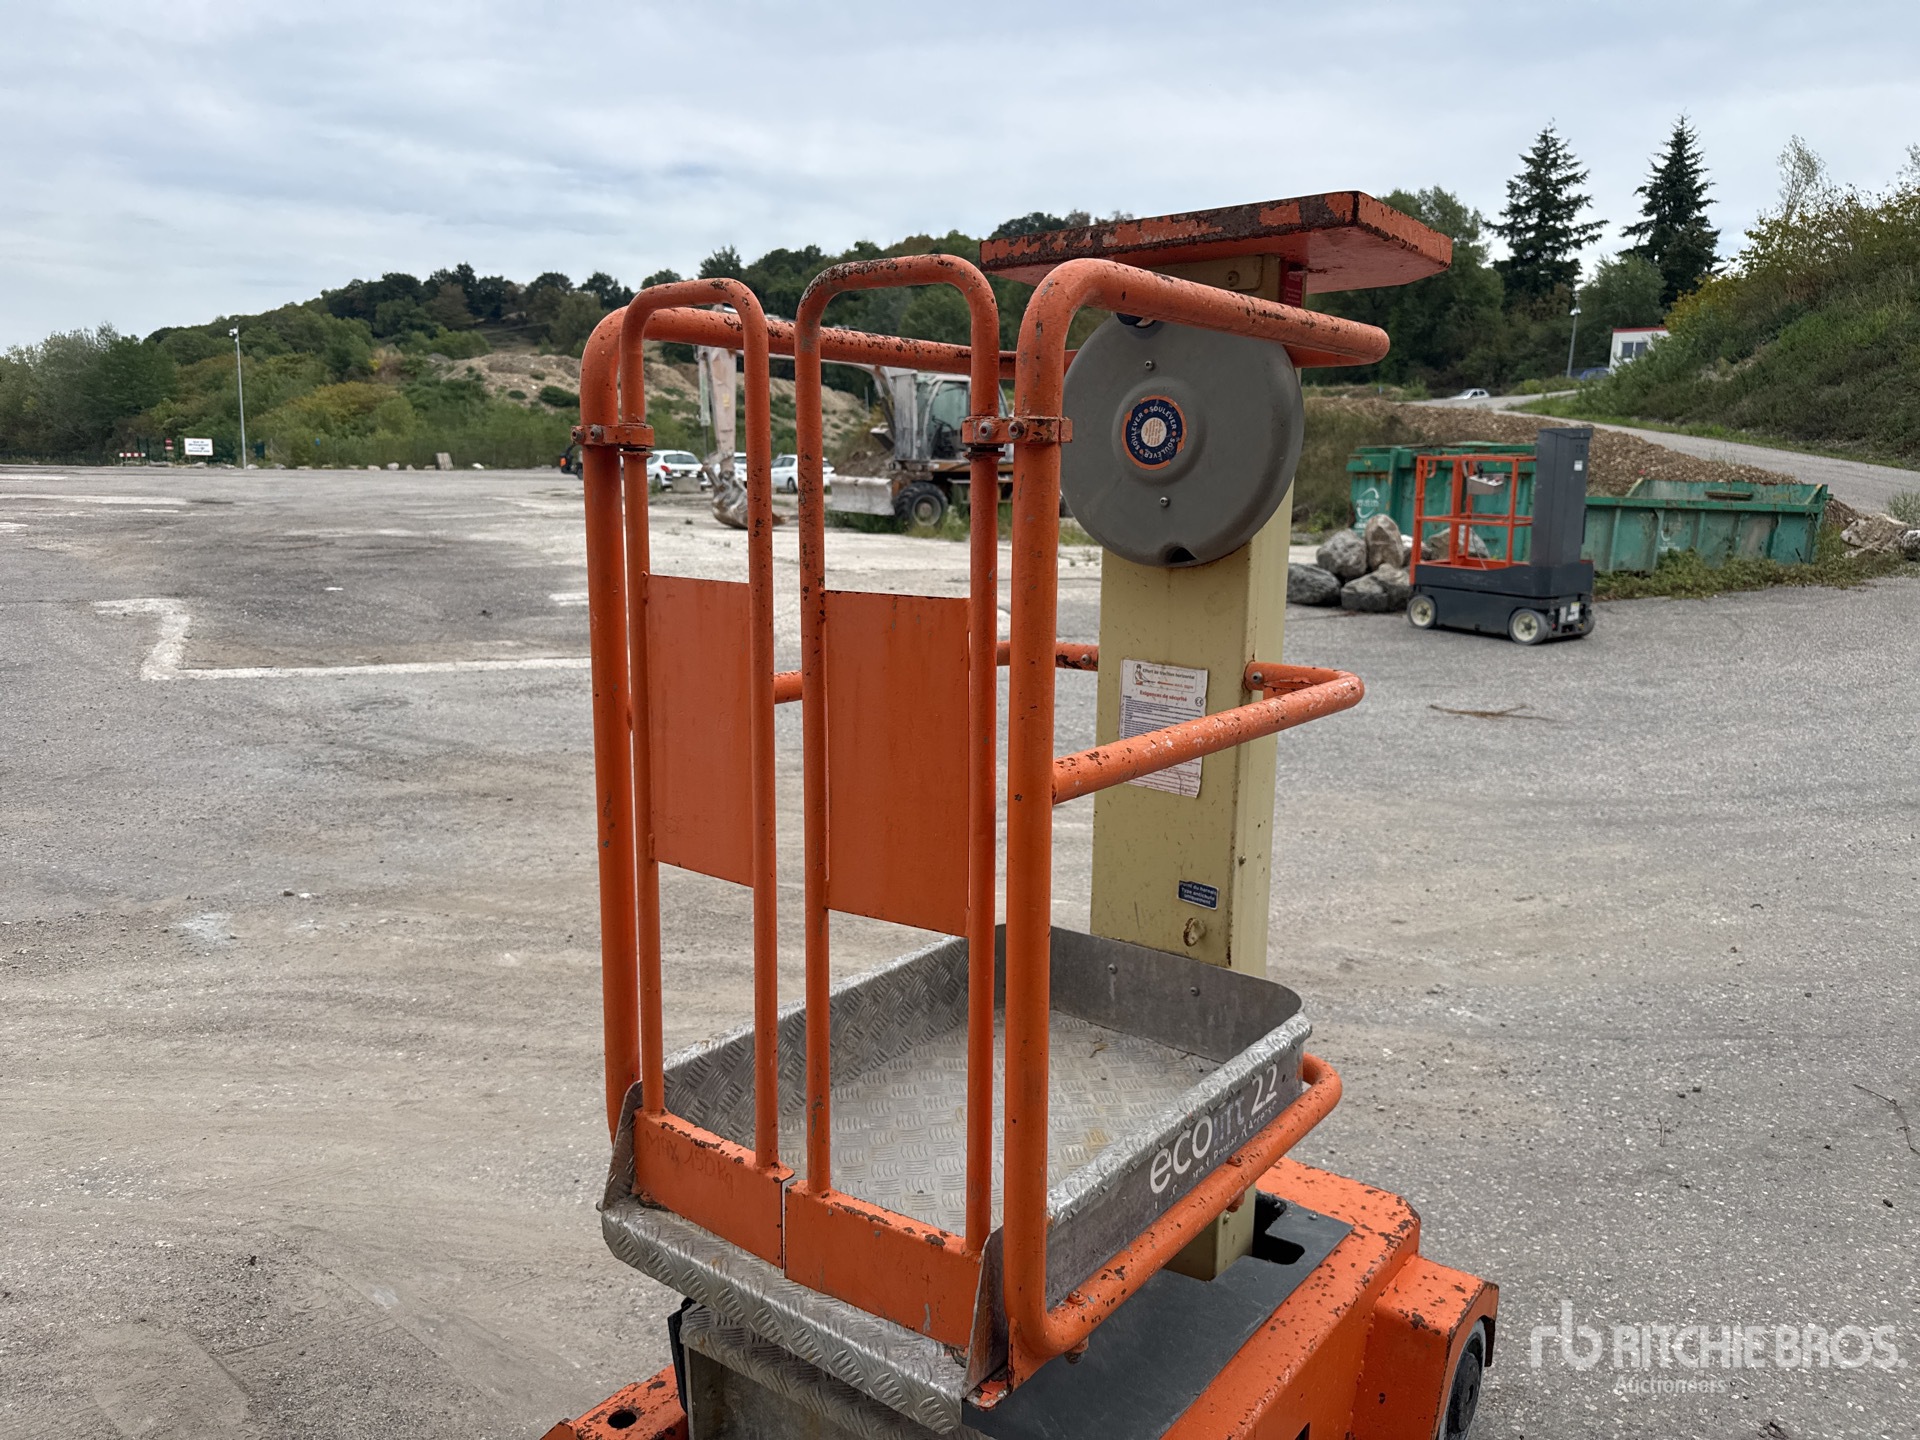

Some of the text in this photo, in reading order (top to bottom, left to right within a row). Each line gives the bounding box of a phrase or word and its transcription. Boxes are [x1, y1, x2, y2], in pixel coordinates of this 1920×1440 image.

[1149, 405, 1177, 429] SOULEVER
[1131, 412, 1144, 451] SOULEVER
[1144, 438, 1176, 459] SOULEVER
[1139, 690, 1162, 699] Exigences
[1169, 694, 1188, 702] sécurité
[1251, 1064, 1278, 1116] 22
